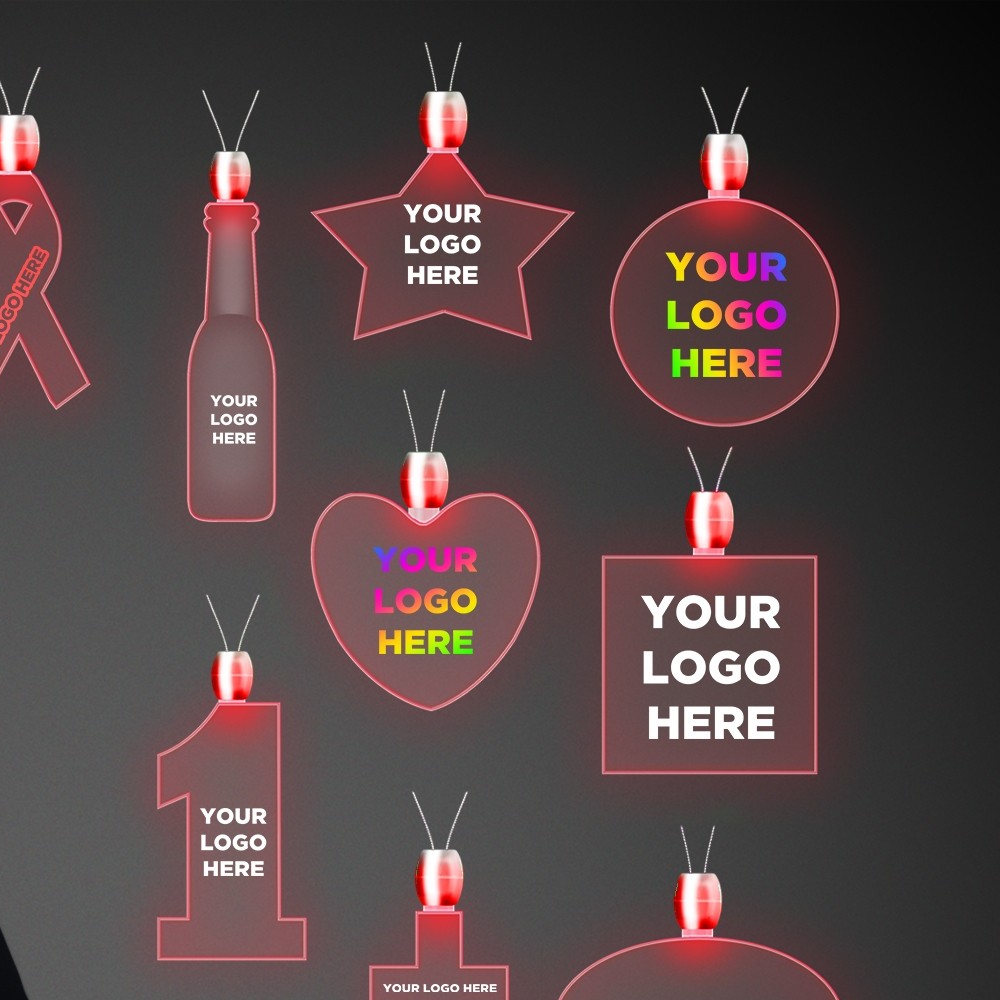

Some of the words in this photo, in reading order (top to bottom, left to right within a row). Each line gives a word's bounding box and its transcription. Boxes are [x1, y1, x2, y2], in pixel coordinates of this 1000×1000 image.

[403, 203, 482, 224] YOUR
[404, 234, 482, 255] LOGO
[12, 246, 50, 297] HERE
[407, 265, 479, 285] HERE
[665, 251, 787, 282] YOUR
[667, 299, 787, 331] LOGO
[671, 348, 783, 378] HERE
[210, 394, 258, 408] YOUR
[210, 413, 258, 426] LOGO
[212, 432, 256, 445] HERE
[373, 546, 478, 574] YOUR
[373, 587, 478, 615] LOGO
[640, 594, 781, 630] YOUR
[378, 629, 474, 655] HERE
[643, 650, 781, 685] LOGO
[648, 705, 775, 740] HERE
[199, 807, 267, 825] YOUR
[200, 833, 267, 852] LOGO
[203, 860, 265, 877] HERE
[382, 983, 420, 993] YOUR
[423, 983, 460, 993] LOGO
[463, 983, 498, 993] HERE
